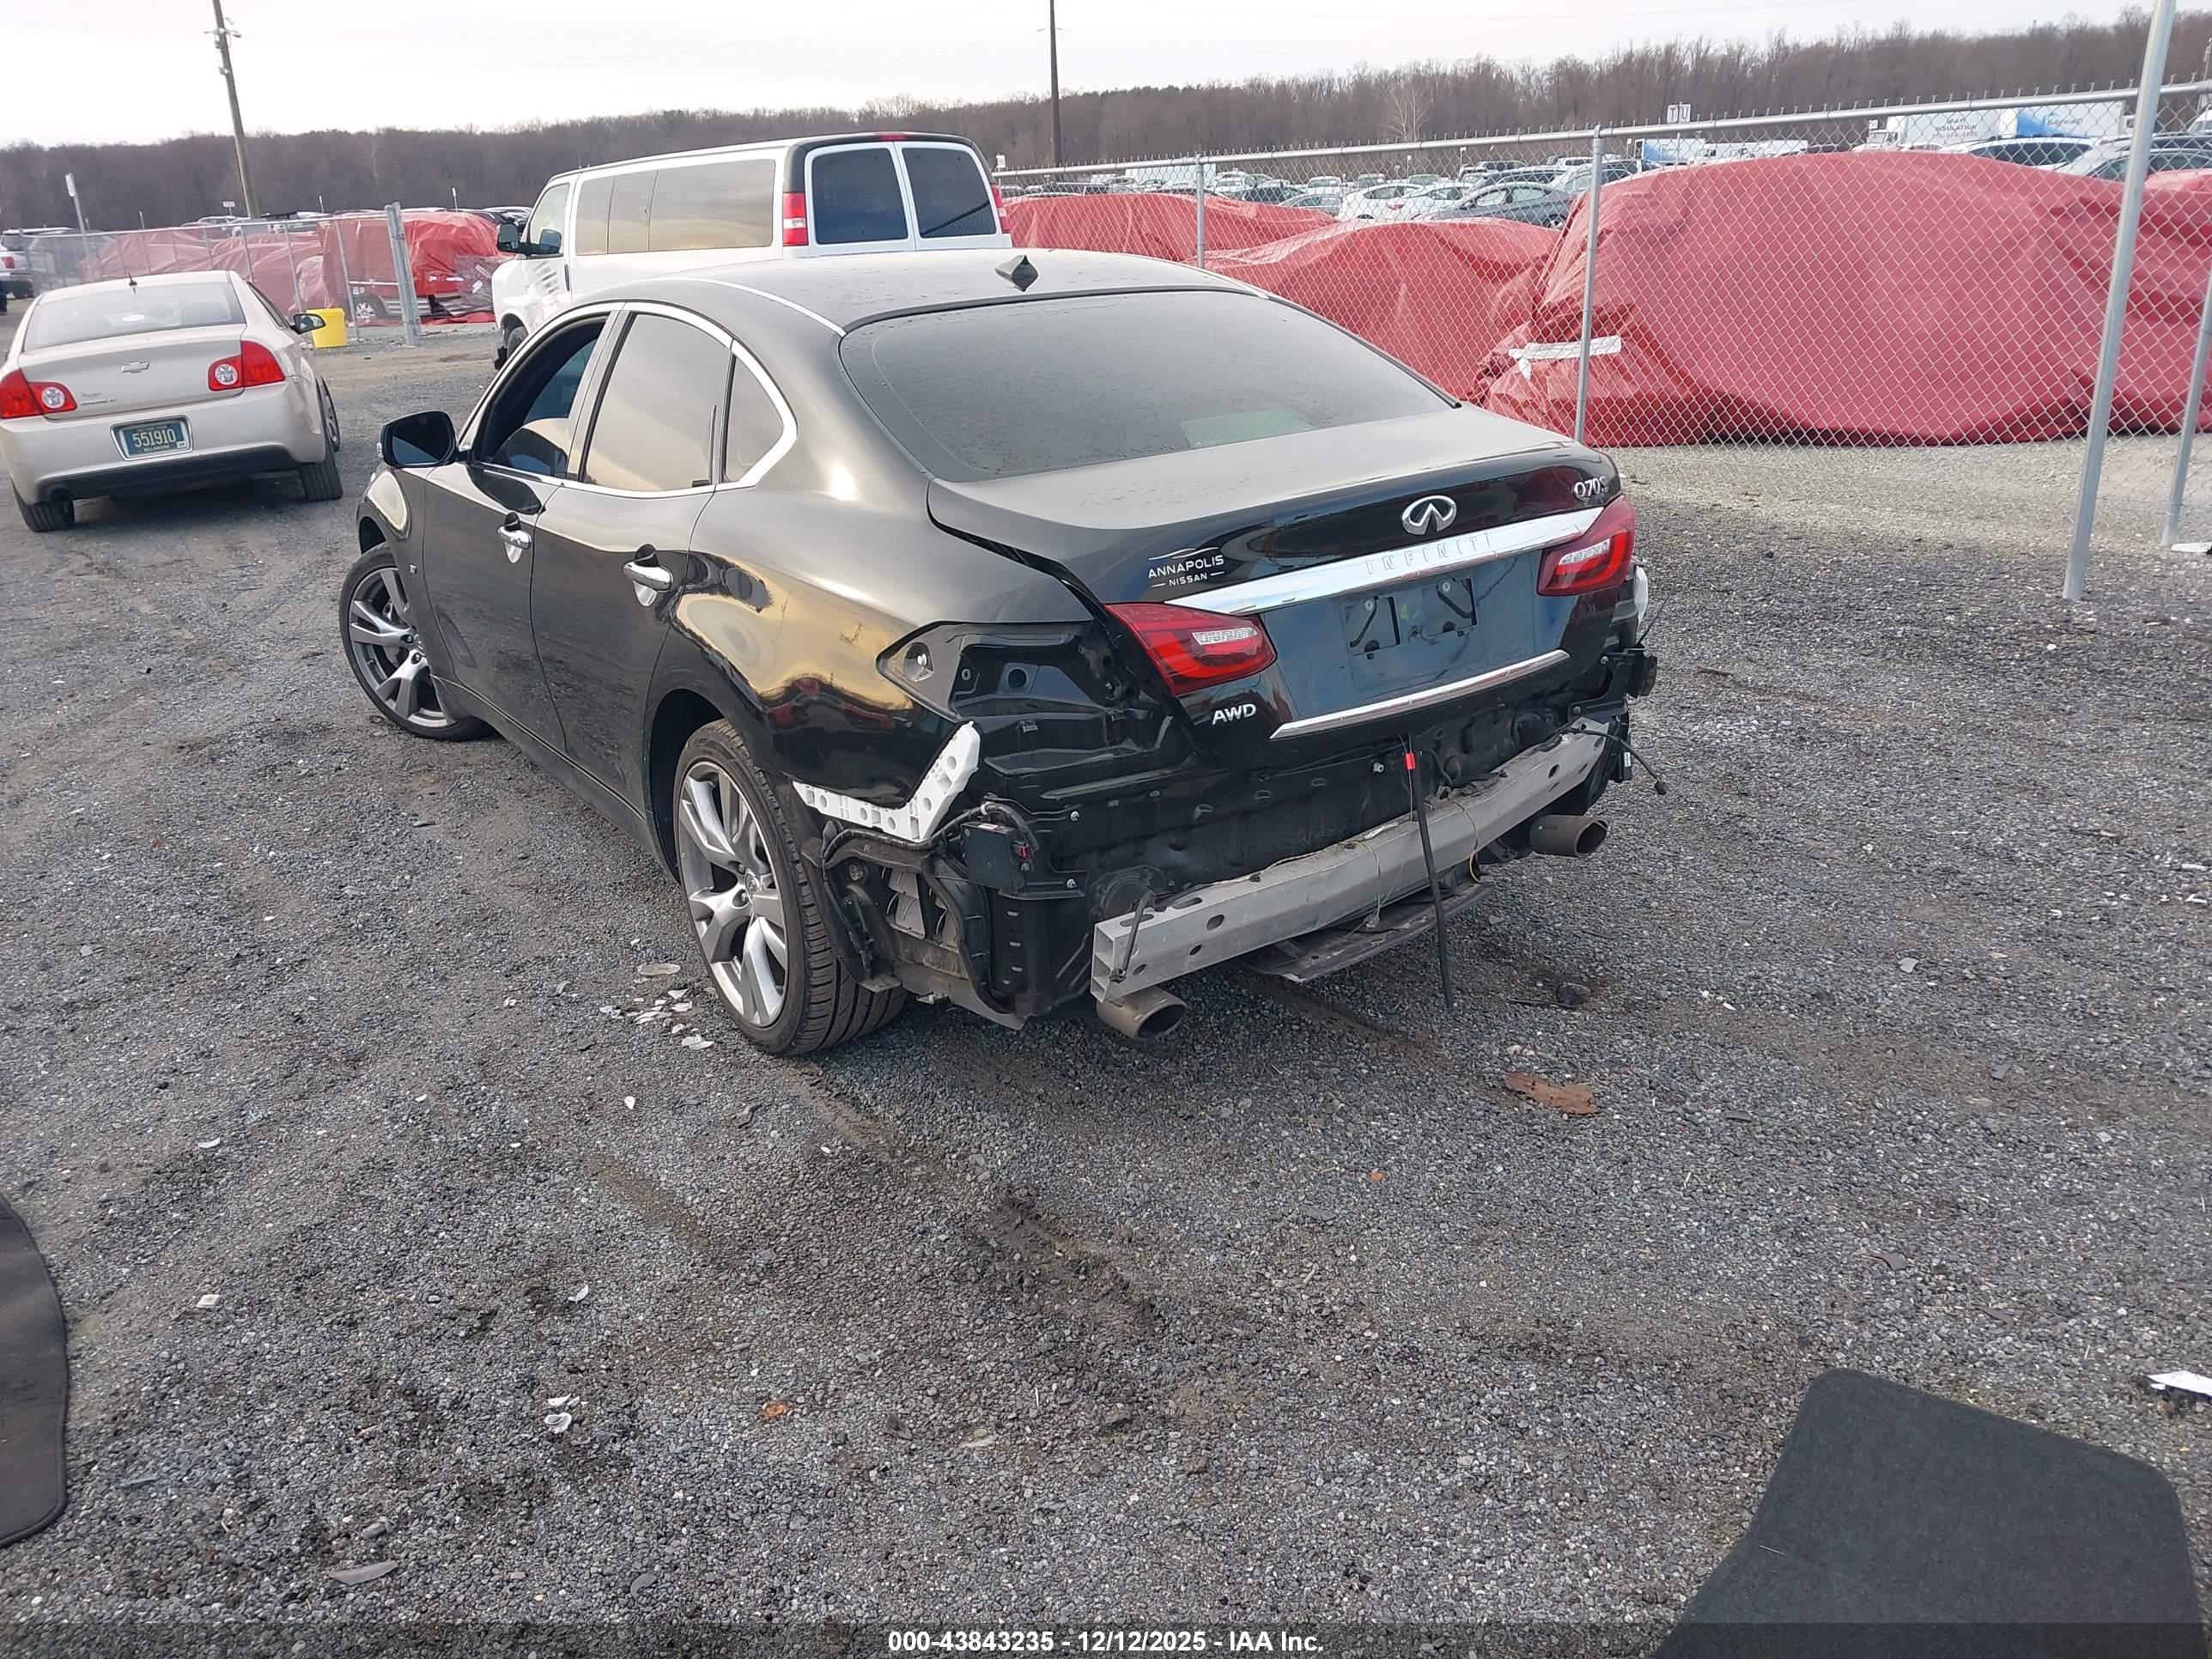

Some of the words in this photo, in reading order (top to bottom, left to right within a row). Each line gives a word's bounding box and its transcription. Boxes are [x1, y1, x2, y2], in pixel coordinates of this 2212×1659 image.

[131, 428, 177, 447] 551910
[1366, 532, 1492, 574] INFINITI
[1148, 555, 1224, 579] ANNAPOLIS
[1169, 573, 1207, 586] NISSAN
[1212, 703, 1256, 726] AWD
